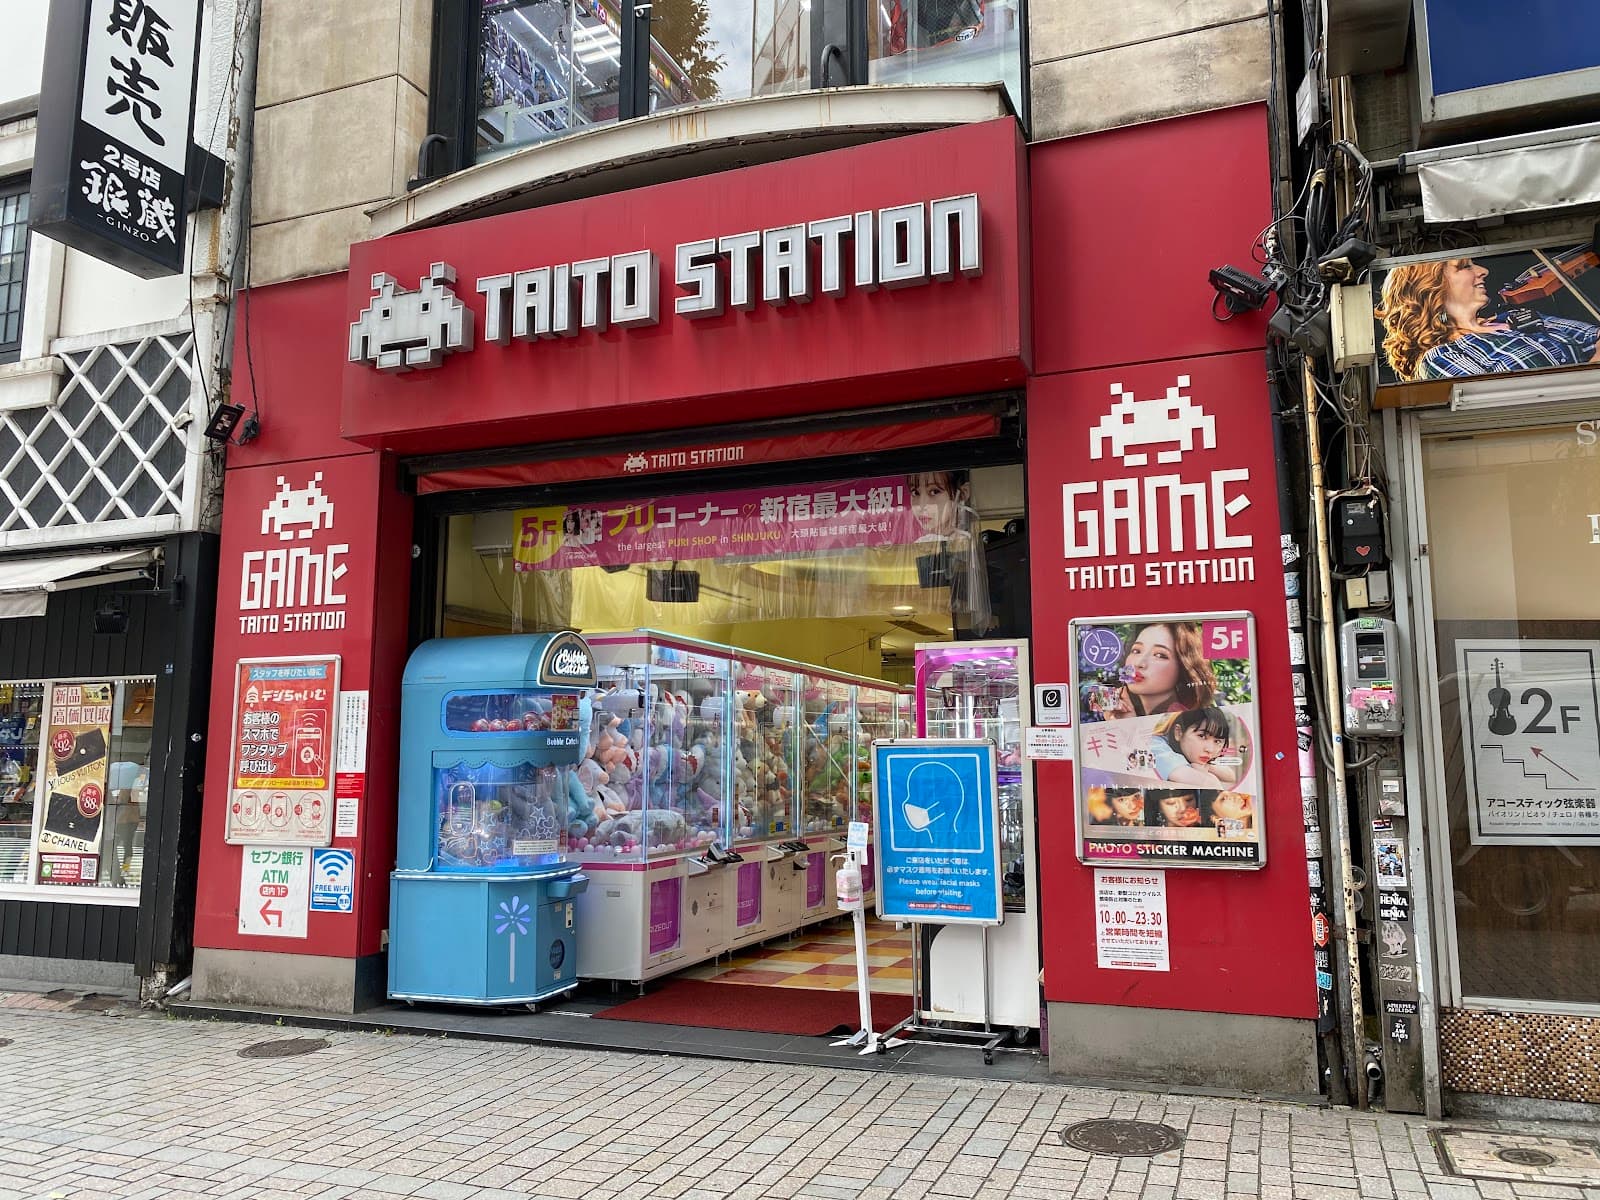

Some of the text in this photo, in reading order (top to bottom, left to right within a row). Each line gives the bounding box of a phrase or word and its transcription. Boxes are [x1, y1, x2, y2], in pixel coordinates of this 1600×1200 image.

[103, 144, 162, 191] 2号店
[476, 193, 983, 346] TAITO STATION
[651, 446, 744, 469] TAITO STATION
[1062, 467, 1253, 559] GAME
[520, 517, 557, 548] 5F
[618, 531, 780, 552] the largest PURI SHOP in SHINJUKU
[239, 543, 349, 611] GAME
[1065, 556, 1255, 590] TAITO STATION
[239, 610, 346, 634] TAITO STATION
[1211, 626, 1244, 650] 5F
[55, 687, 81, 705] 新品
[242, 711, 280, 725] お客様の
[1520, 687, 1582, 734] 2F
[241, 728, 279, 741] スマホで
[1486, 798, 1597, 809] アコースティック弦楽器
[51, 835, 89, 852] CHANEL
[1137, 844, 1188, 856] STICKER
[1192, 846, 1254, 858] MACHINE
[251, 850, 304, 866] セブン銀行
[261, 869, 289, 884] ATM
[898, 877, 920, 886] Please
[959, 879, 981, 888] masks
[314, 884, 332, 892] FREE
[915, 887, 937, 896] before
